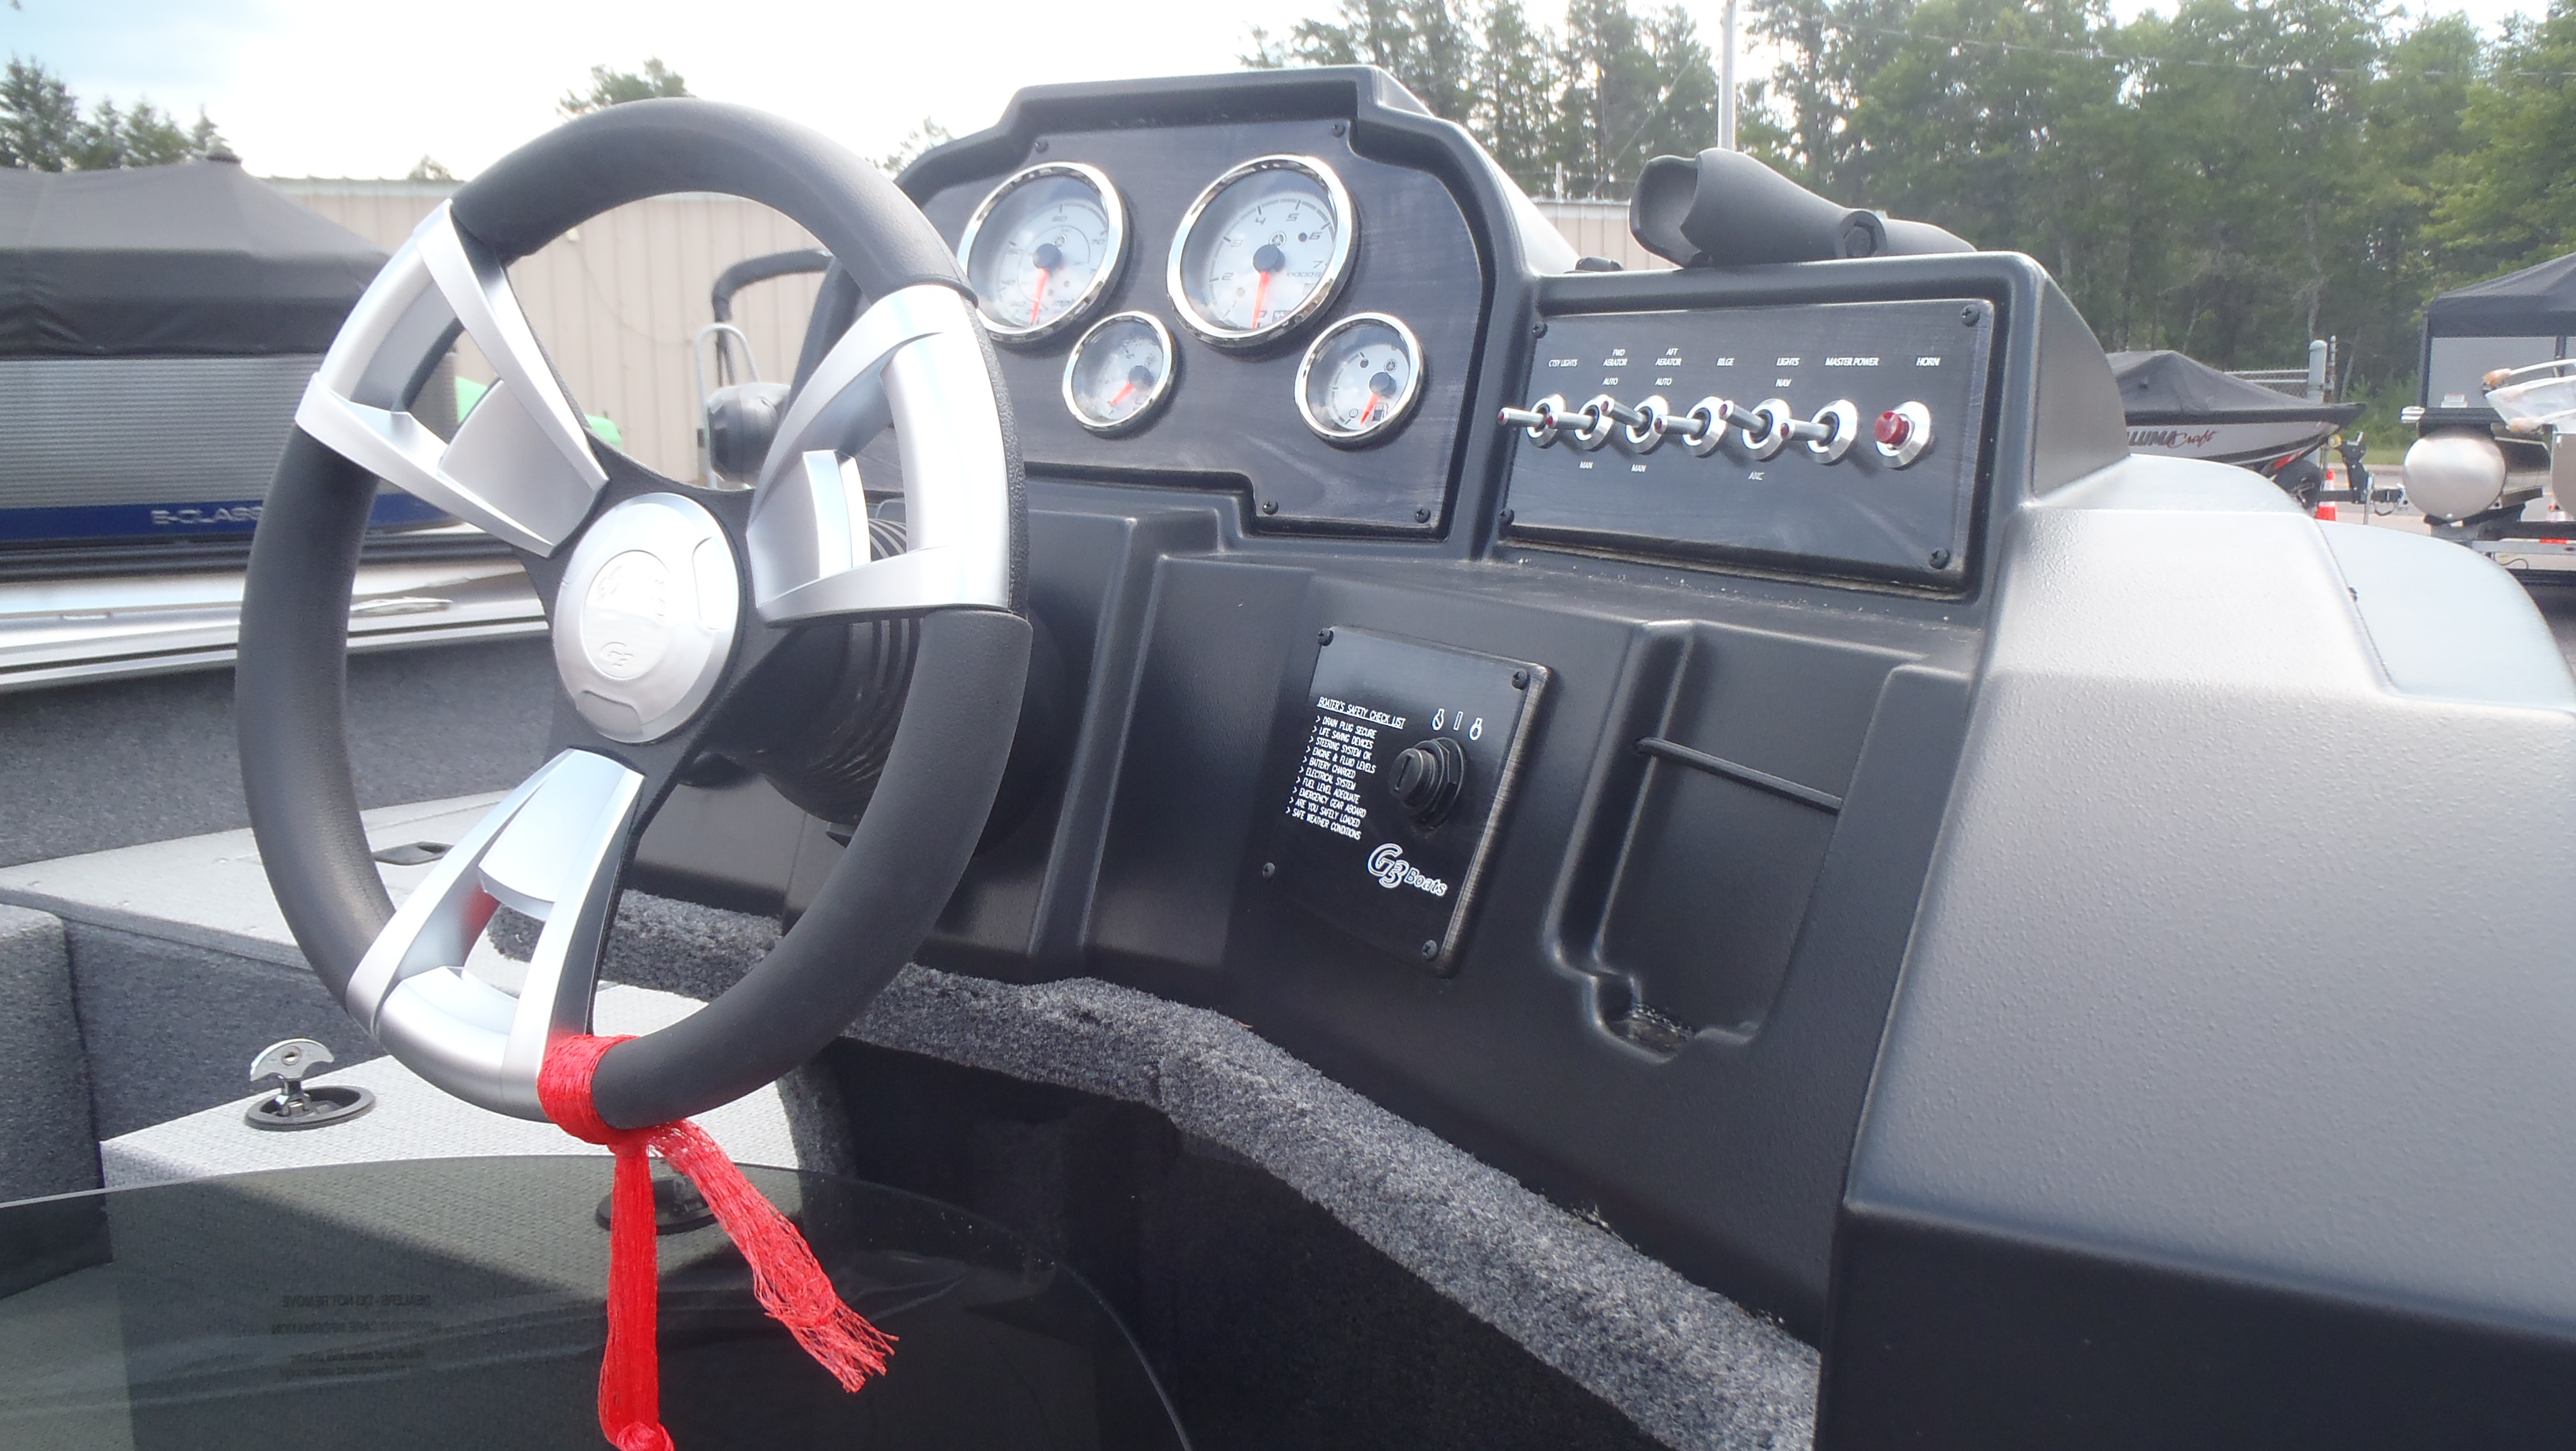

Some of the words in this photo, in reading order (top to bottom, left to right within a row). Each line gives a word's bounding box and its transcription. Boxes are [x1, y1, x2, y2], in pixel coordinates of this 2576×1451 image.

[1286, 213, 1299, 222] 5
[1308, 232, 1322, 240] 6
[1655, 358, 1681, 366] AERATOR
[1716, 357, 1735, 366] BILGE
[1776, 357, 1800, 366] LIGHTS
[1824, 357, 1852, 366] MASTER
[1852, 357, 1880, 366] POWER
[1916, 357, 1940, 367] HORN
[1775, 378, 1791, 387] NAV
[1579, 461, 1593, 469] MAN
[1631, 464, 1647, 473] MAN
[1347, 704, 1368, 717] SAFETY
[1370, 710, 1391, 724] CHECK
[1392, 716, 1406, 728] LIST
[1319, 727, 1331, 737] LIFE
[1331, 730, 1350, 742] SAVING
[1351, 735, 1374, 750] DEVICES
[1322, 716, 1338, 728] DRAIN
[1339, 721, 1353, 733] PLUG
[1355, 726, 1378, 739] SECURE
[1316, 737, 1340, 751] STEERING
[1341, 744, 1362, 758] SYSTEM
[1362, 751, 1372, 760] OK
[1309, 757, 1331, 771] BATTERY
[1332, 765, 1356, 779] CHARGED
[1312, 747, 1332, 760] ENGINE
[1340, 755, 1355, 767] FLUID
[1356, 760, 1376, 774] LEVELS
[1305, 767, 1333, 784] ELECTRICAL
[1335, 777, 1356, 790] SYSTEM
[1302, 777, 1315, 789] FUEL
[1317, 782, 1331, 795] LEVEL
[1333, 788, 1361, 804] ADEQUATE
[1295, 798, 1307, 808] ARE
[1308, 802, 1319, 813] YOU
[1319, 807, 1339, 820] SAFELY
[1340, 813, 1361, 828] LOADED
[1299, 787, 1329, 804] EMERGENCY
[1329, 798, 1344, 810] GEAR
[1344, 804, 1367, 818] ABOARD
[1292, 808, 1306, 820] SAFE
[1307, 813, 1329, 828] WEATHER
[1330, 822, 1362, 840] CONDITIONS
[1368, 843, 1409, 888] G3
[1404, 867, 1447, 896] Boats
